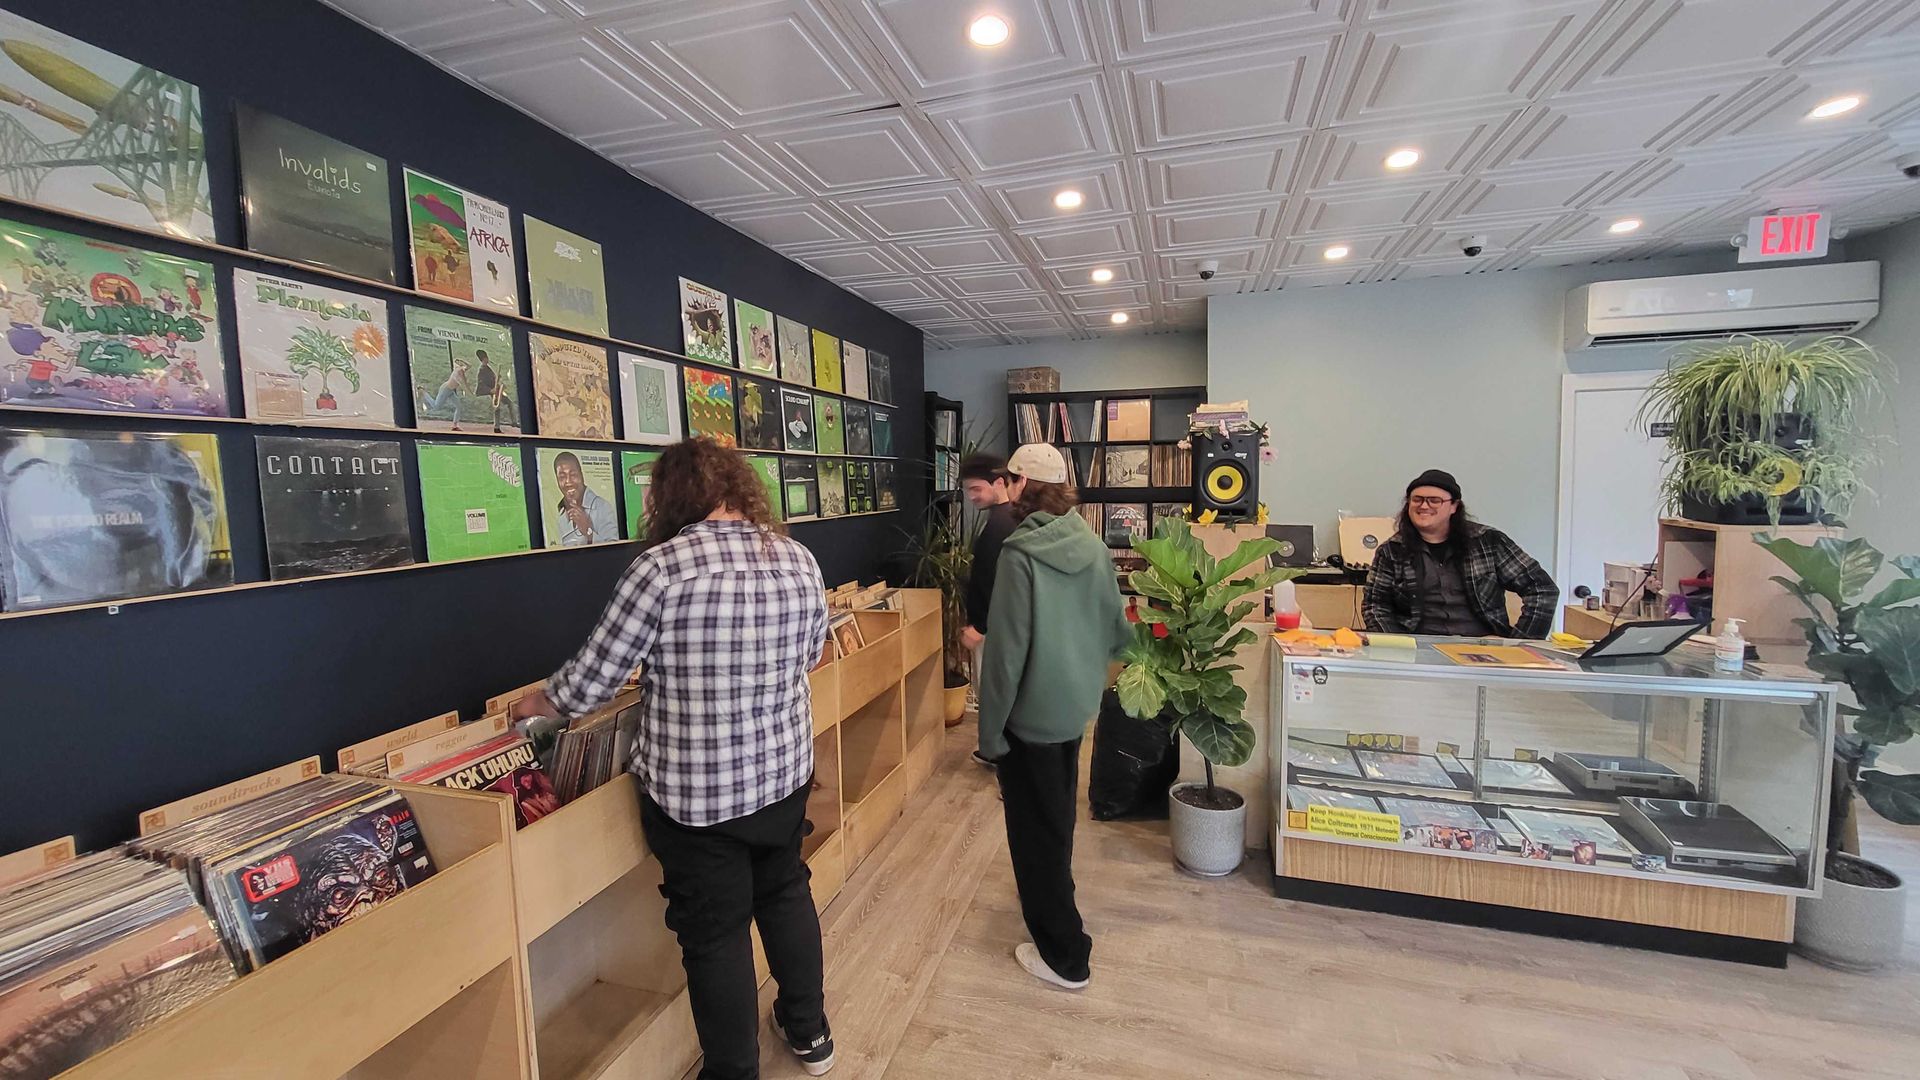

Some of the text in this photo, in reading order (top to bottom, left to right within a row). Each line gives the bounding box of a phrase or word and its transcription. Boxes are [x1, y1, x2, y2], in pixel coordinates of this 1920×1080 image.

[279, 147, 361, 193] Invalids
[469, 226, 511, 258] AFRICA
[1760, 213, 1821, 255] EXIT
[256, 284, 372, 322] Plantasia
[417, 325, 433, 334] FROM
[437, 329, 460, 339] VIENNA
[267, 455, 399, 475] CONTACT
[105, 511, 143, 526] REALM
[436, 743, 535, 790] ACK UHURU
[191, 776, 281, 814] soundtracks
[1310, 807, 1327, 816] Keep
[1311, 816, 1326, 824] Alice
[1360, 822, 1374, 831] 1971
[811, 1034, 826, 1049] NIKE
